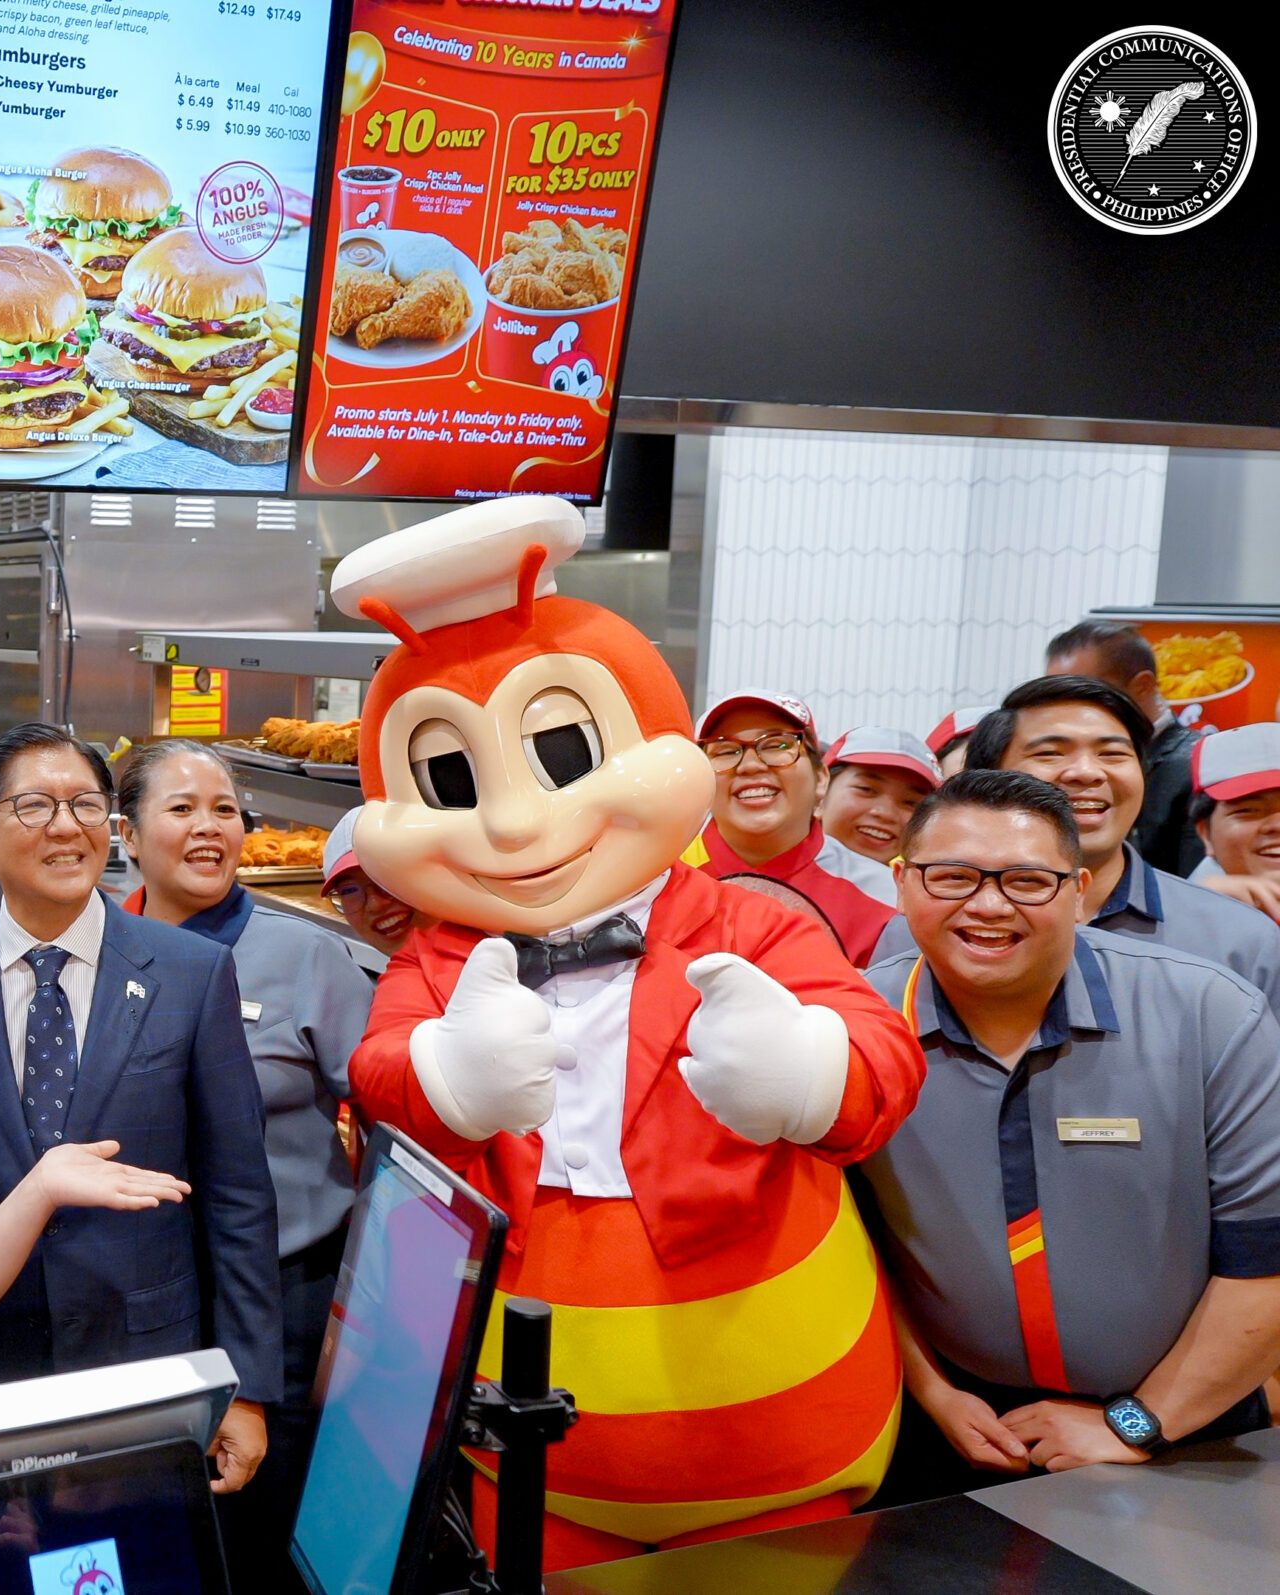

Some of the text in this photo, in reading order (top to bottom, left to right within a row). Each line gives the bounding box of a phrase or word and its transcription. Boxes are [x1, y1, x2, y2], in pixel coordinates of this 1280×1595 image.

[218, 1, 301, 22] $12.49 $17.49
[17, 25, 45, 37] Aloha
[29, 11, 62, 26] bacon,
[65, 18, 92, 28] green
[94, 18, 113, 30] leaf
[114, 20, 149, 35] lettuce,
[393, 26, 627, 69] Celebrating 10 Years in Canada
[47, 80, 118, 99] Yumburger
[184, 75, 192, 85] la
[195, 78, 220, 89] carte
[236, 82, 261, 93] Meal
[283, 86, 299, 97] Cal
[226, 97, 261, 112] $11.49
[268, 103, 312, 118] 410-1080
[224, 121, 261, 136] $10.99
[265, 127, 311, 141] 360-1030
[363, 108, 485, 153] $10 ONLY
[25, 165, 52, 177] Aloha
[54, 167, 87, 181] Burger
[426, 170, 462, 183] 2pc Jolly
[506, 165, 636, 194] FOR $35 ONLY
[209, 178, 265, 208] 100%
[404, 178, 429, 191] Crispy
[430, 181, 462, 192] Chicken
[463, 183, 484, 194] Meal
[212, 201, 269, 227] ANGUS
[516, 201, 616, 218] Jolly Crispy Chicken Bucket
[218, 221, 266, 239] MADE FRESH
[225, 231, 262, 246] TO ORDER
[493, 316, 538, 336] Jollibee
[96, 378, 191, 392] Angus Cheeseburger
[334, 405, 583, 431] Promo starts July 1. Monday to Friday only.
[26, 431, 122, 444] Angus Deluxe Burger
[327, 424, 586, 447] Available for Dine-In, Take-Out & Drive-Thru
